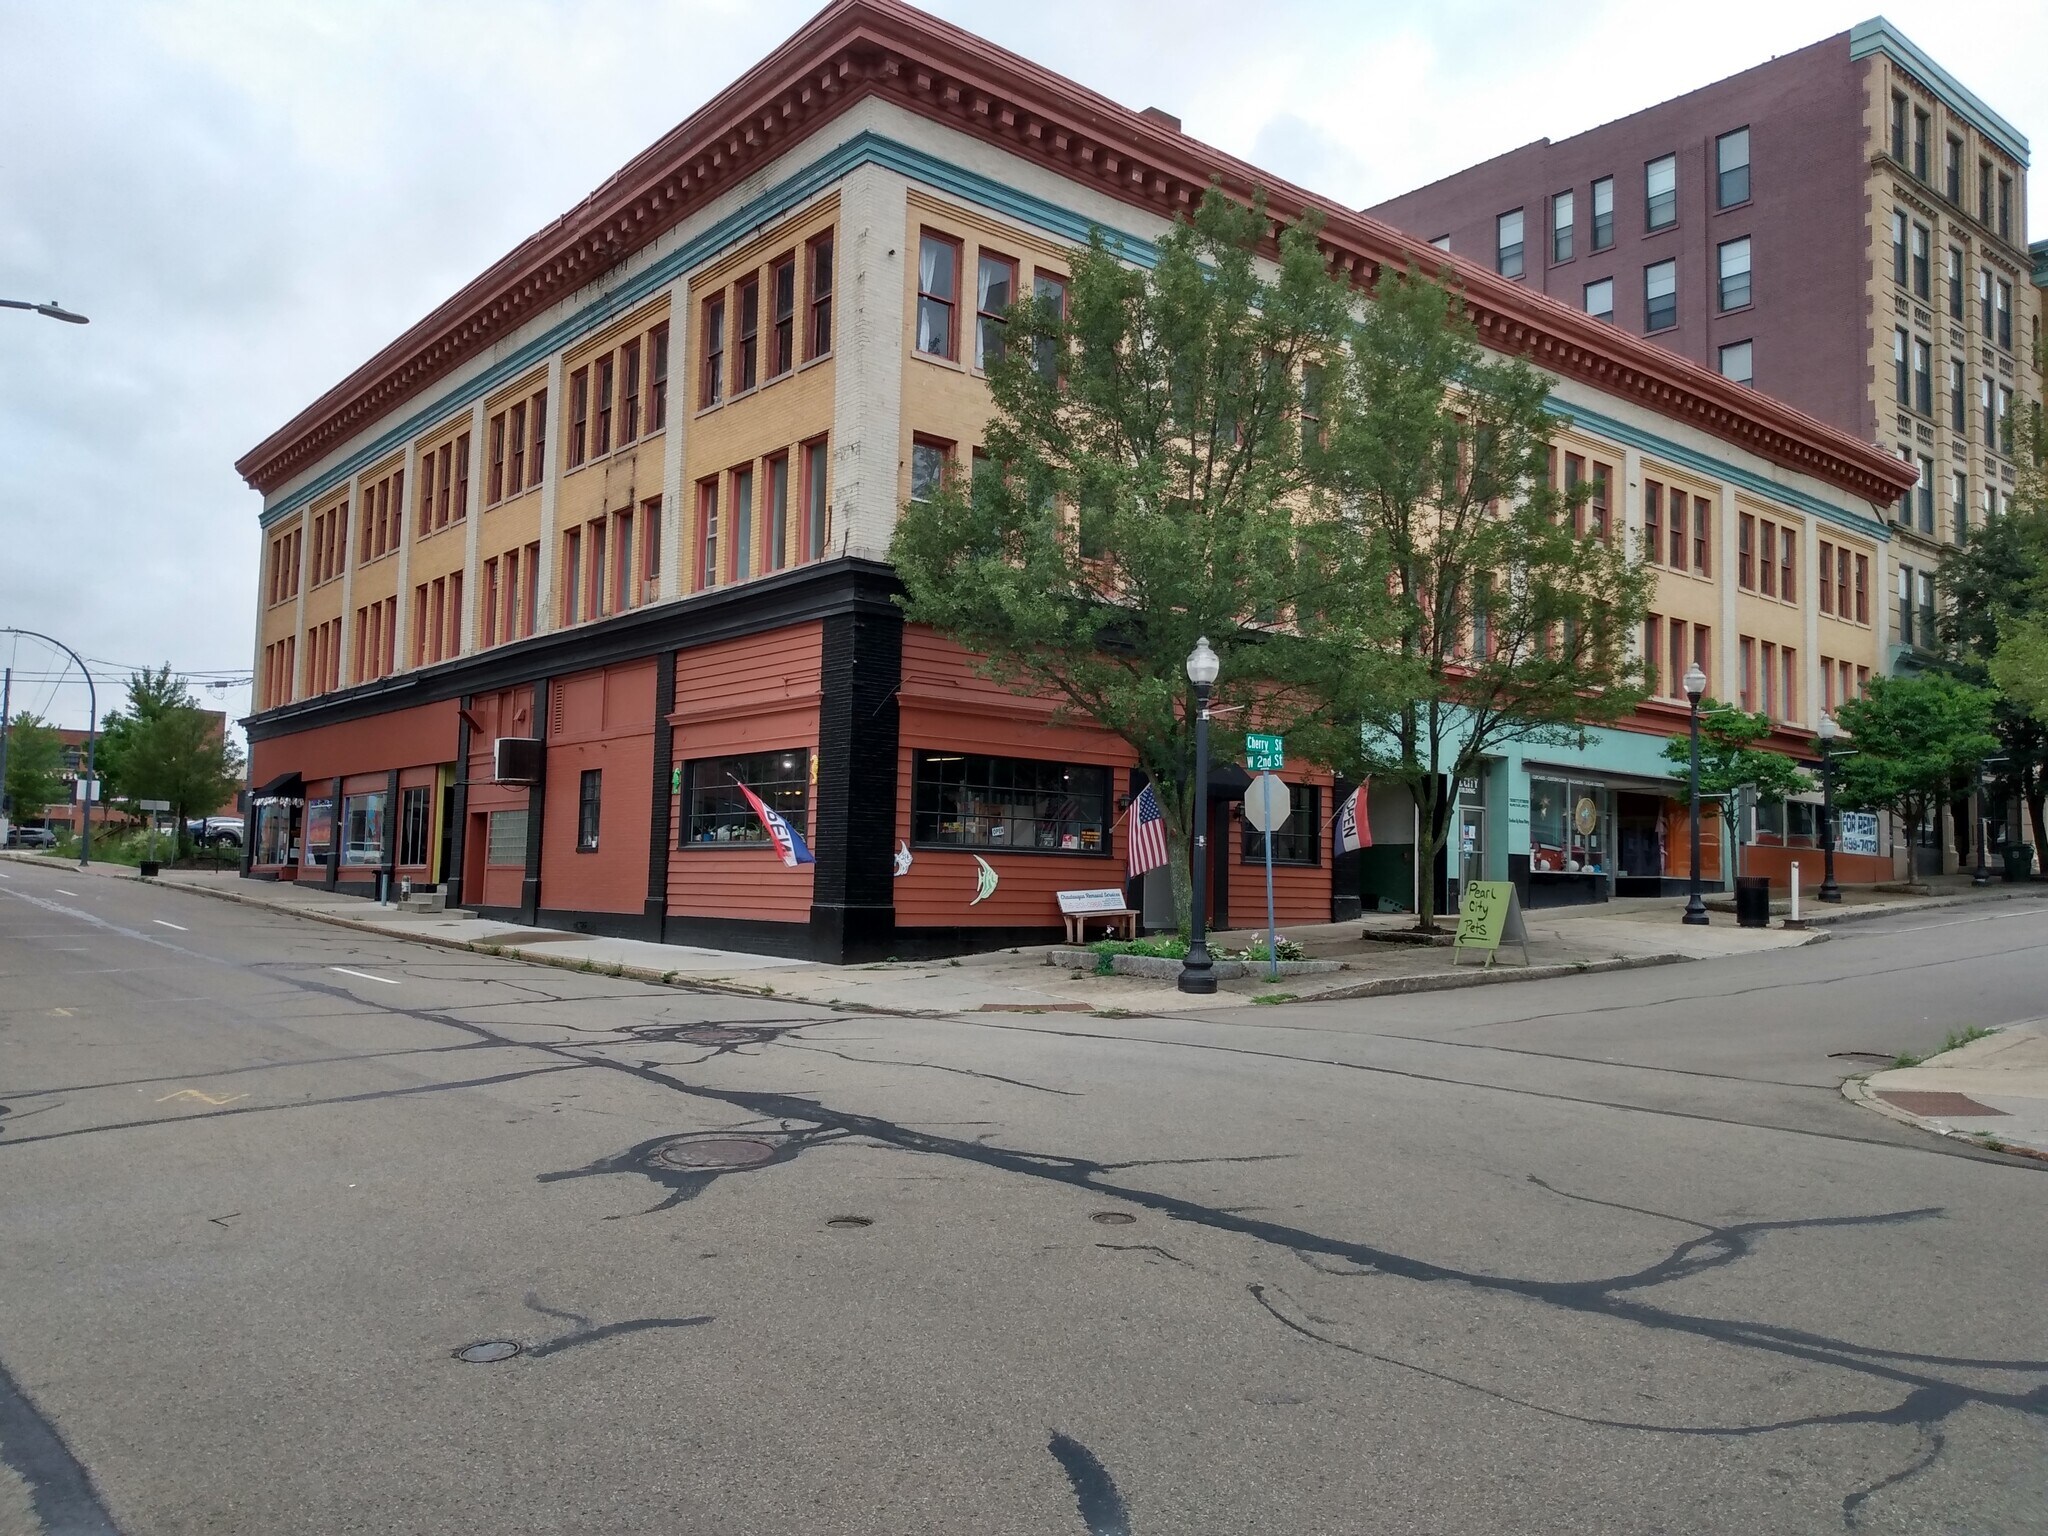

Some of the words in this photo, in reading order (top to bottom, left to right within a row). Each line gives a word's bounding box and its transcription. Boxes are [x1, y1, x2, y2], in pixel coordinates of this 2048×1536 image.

[1247, 736, 1269, 751] Cherry
[1274, 738, 1282, 751] St
[1247, 756, 1254, 768] W
[1257, 755, 1271, 767] 2nd
[1274, 754, 1283, 767] St
[1343, 798, 1357, 838] OPEN
[1843, 813, 1856, 832] FOR
[1858, 815, 1876, 835] RENT
[1469, 882, 1496, 899] Pearl
[1469, 901, 1488, 921] City
[1464, 920, 1487, 935] Pets
